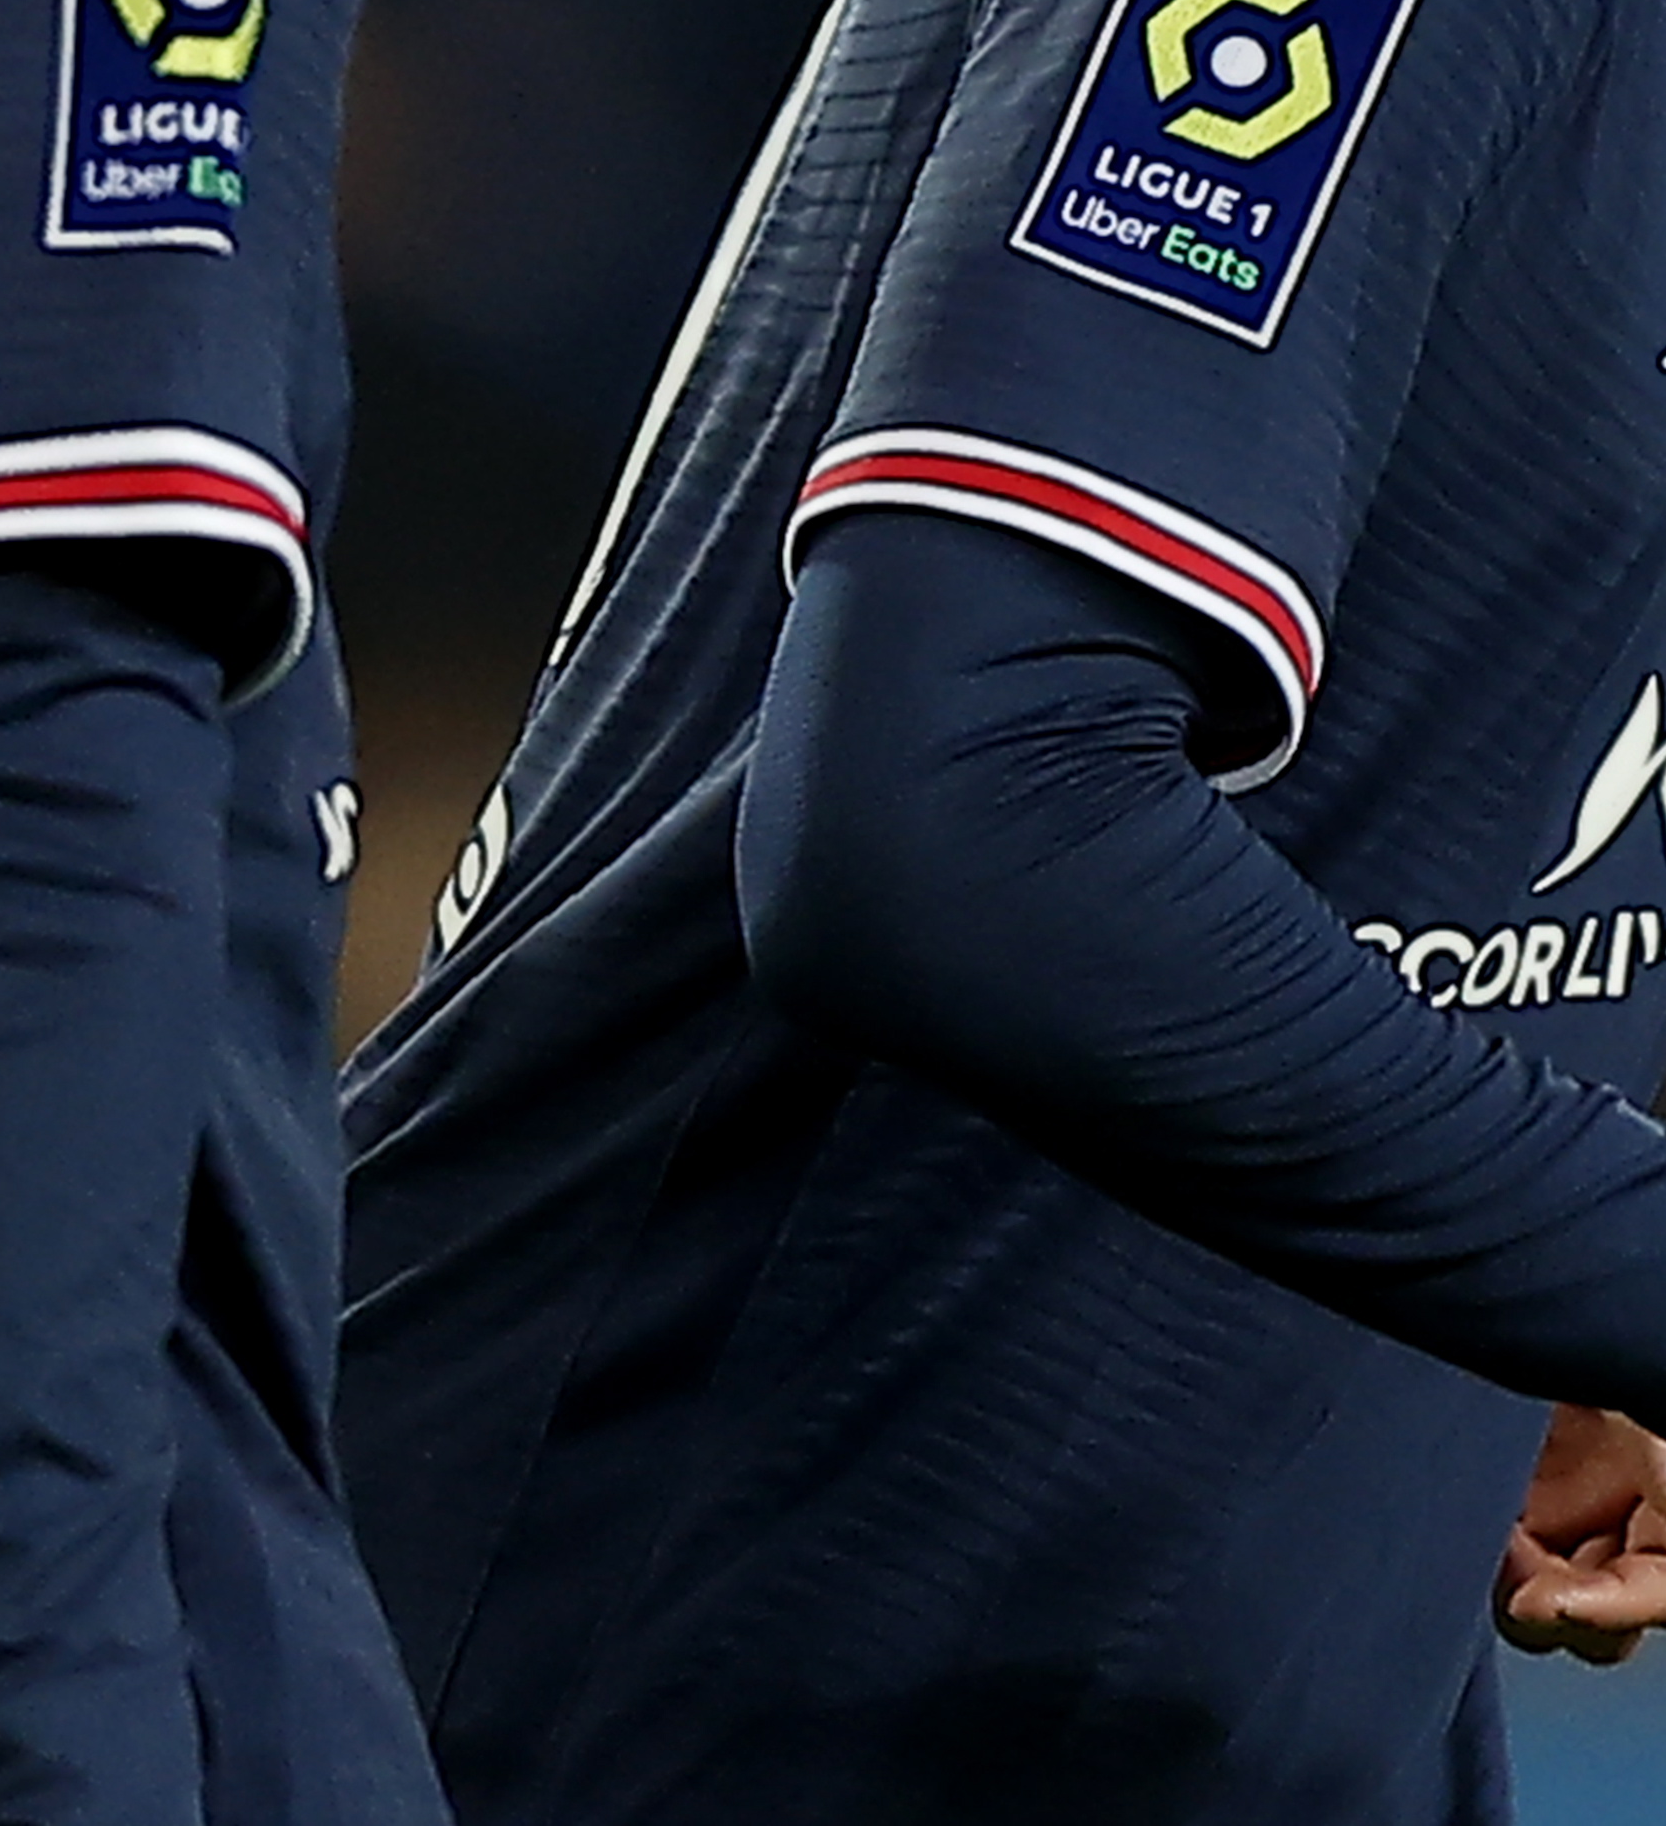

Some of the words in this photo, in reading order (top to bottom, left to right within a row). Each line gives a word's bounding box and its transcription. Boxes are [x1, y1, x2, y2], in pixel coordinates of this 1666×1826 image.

[1060, 188, 1162, 251] Uber
[1160, 223, 1261, 291] Eats
[1093, 145, 1242, 225] LIGUE
[1249, 203, 1273, 238] 1
